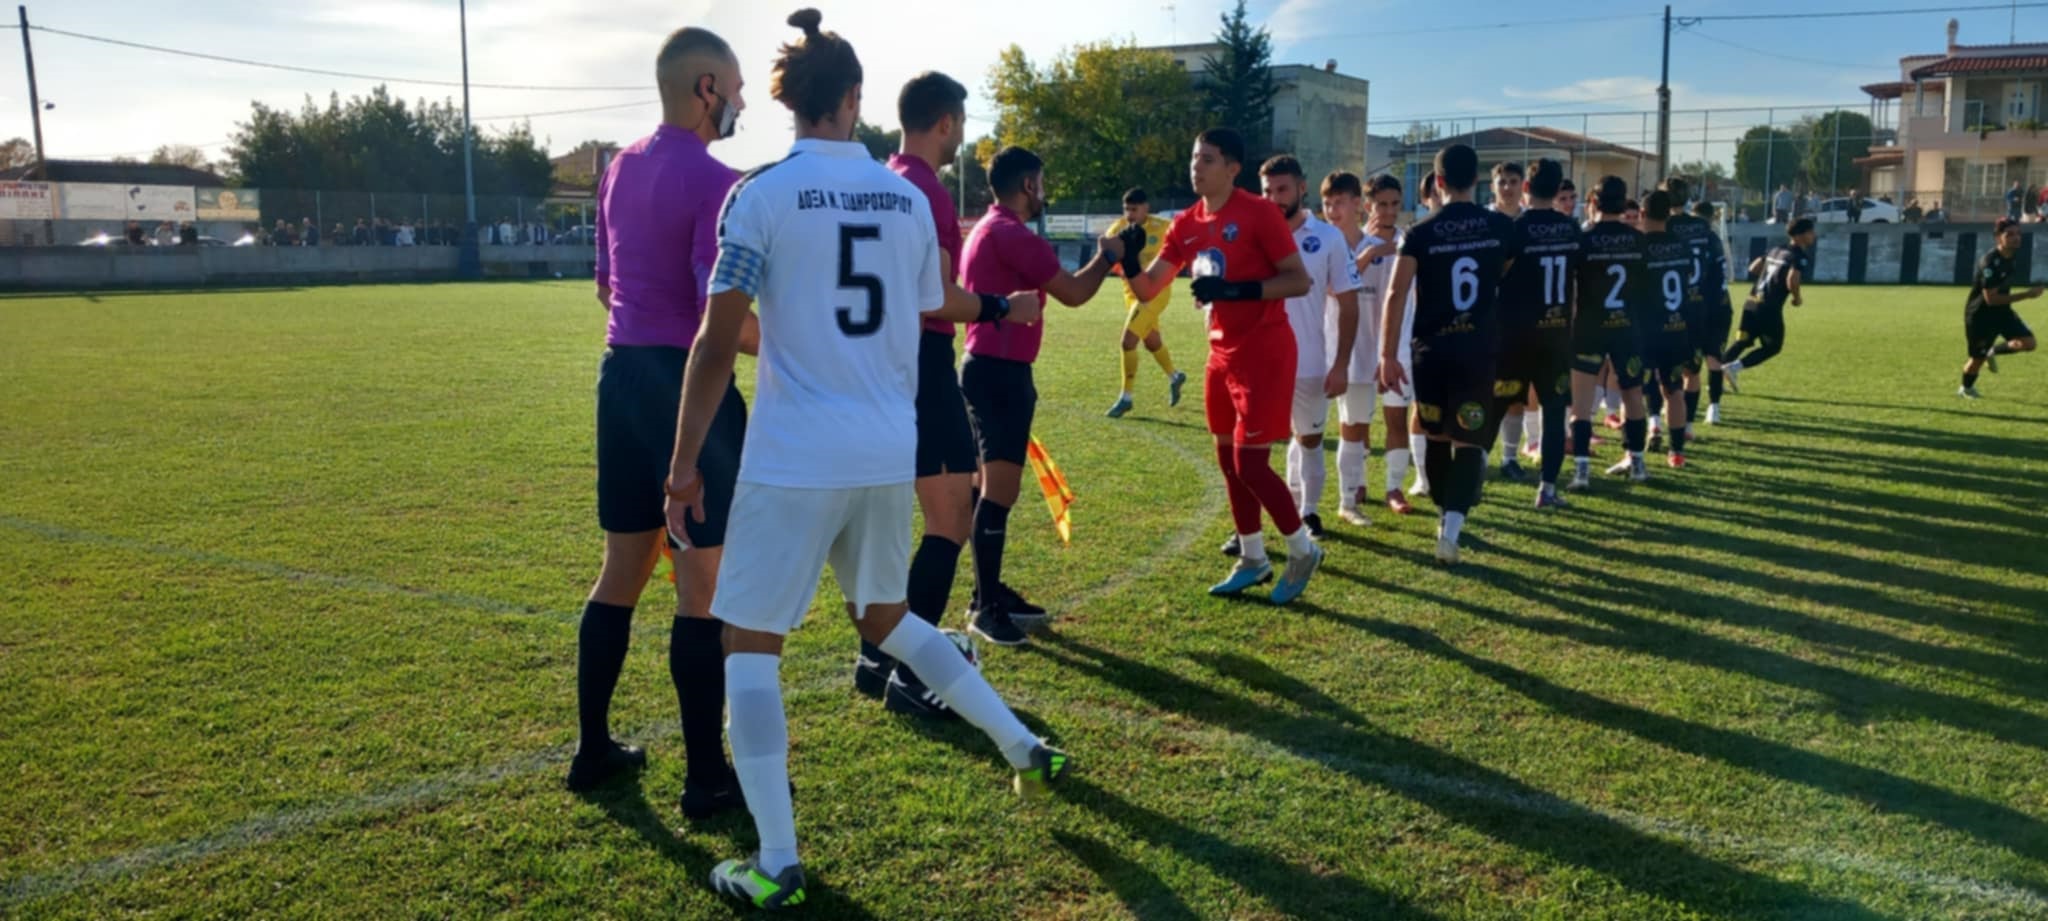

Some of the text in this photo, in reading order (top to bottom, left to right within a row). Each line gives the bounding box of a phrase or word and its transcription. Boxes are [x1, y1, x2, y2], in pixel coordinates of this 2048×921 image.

[798, 190, 827, 210] ΔΟΞΑ
[837, 223, 884, 337] 5
[1452, 256, 1479, 311] 6
[1540, 256, 1567, 304] 11
[1604, 264, 1627, 308] 2
[1663, 270, 1682, 311] 9
